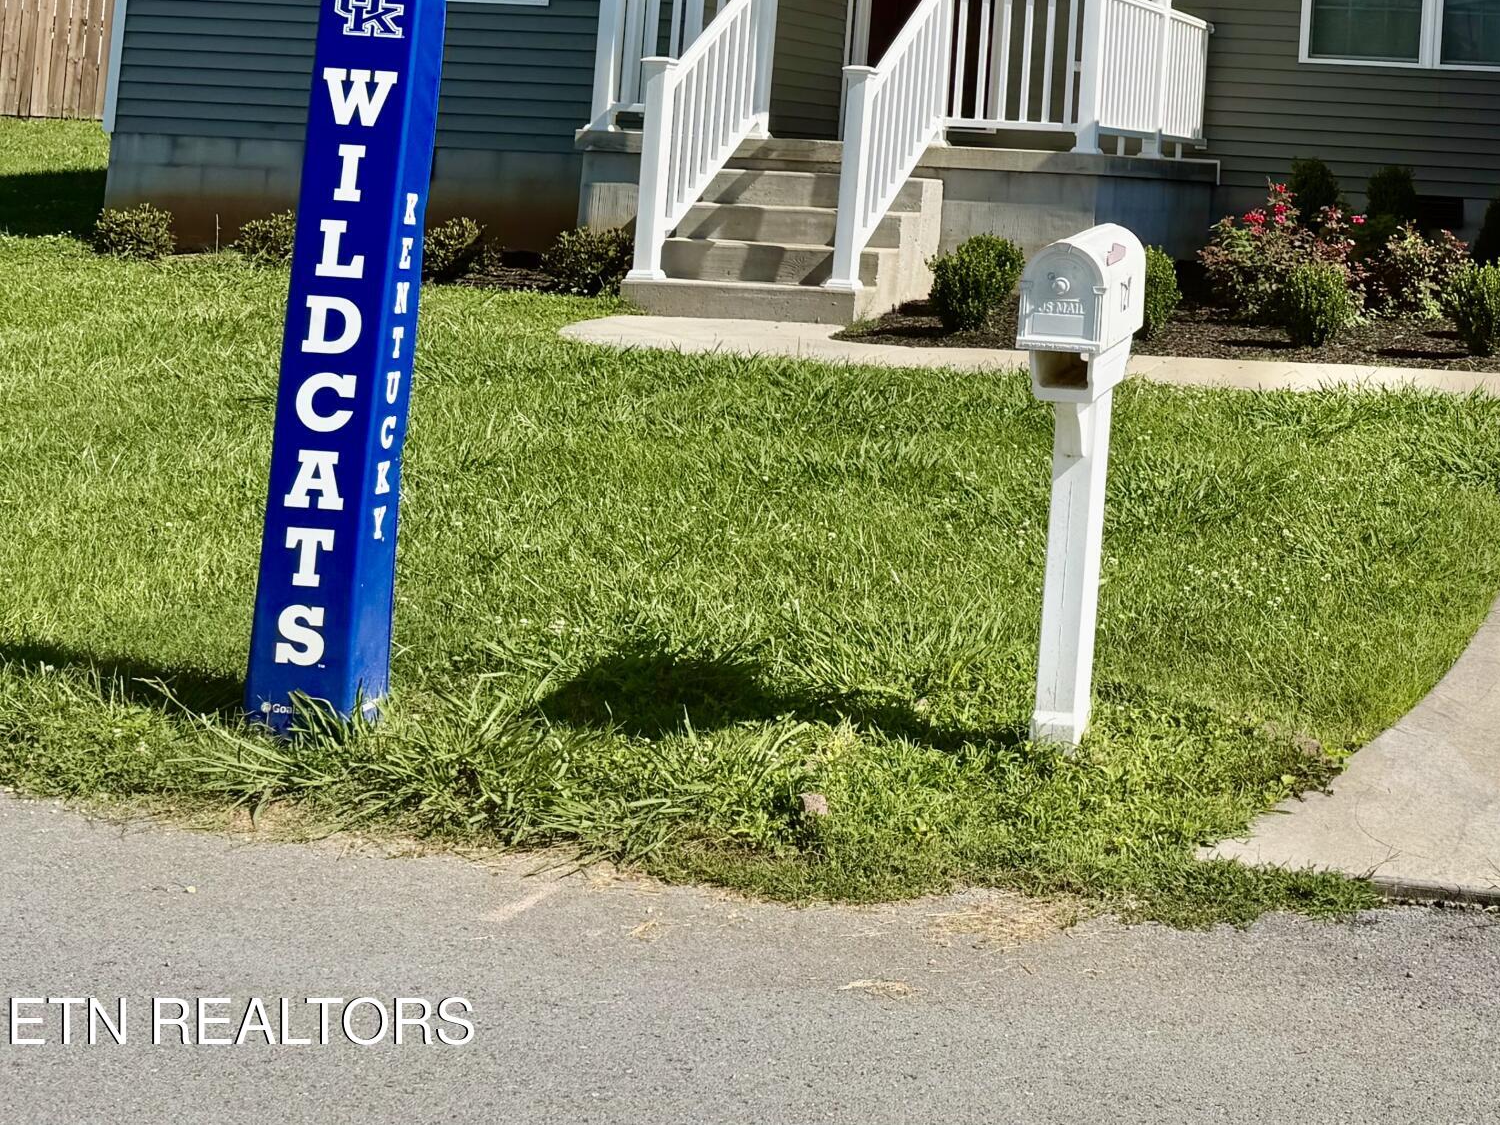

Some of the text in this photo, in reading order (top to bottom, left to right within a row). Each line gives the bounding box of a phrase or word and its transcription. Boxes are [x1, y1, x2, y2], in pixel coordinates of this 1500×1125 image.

[274, 67, 398, 666] WILDCATS
[373, 193, 419, 540] KENTUCKY
[1055, 301, 1086, 314] MAIL
